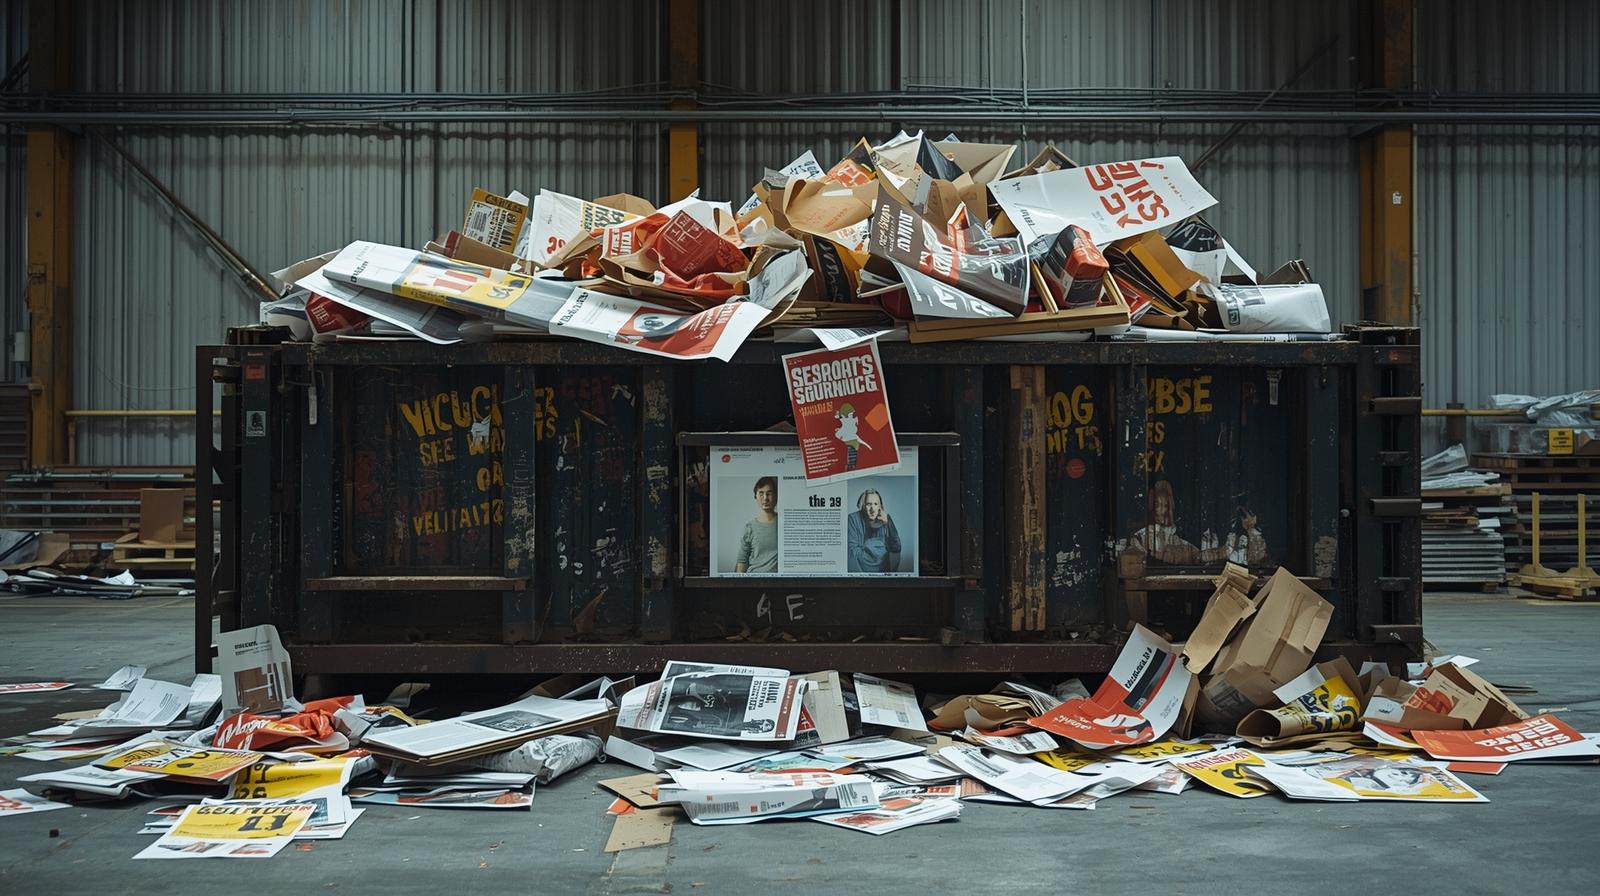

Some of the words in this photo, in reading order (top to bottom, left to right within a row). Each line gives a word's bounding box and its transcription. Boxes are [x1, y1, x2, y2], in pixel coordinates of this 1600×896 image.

[1046, 384, 1094, 428] OG
[1145, 375, 1213, 415] BSE
[809, 494, 826, 508] the
